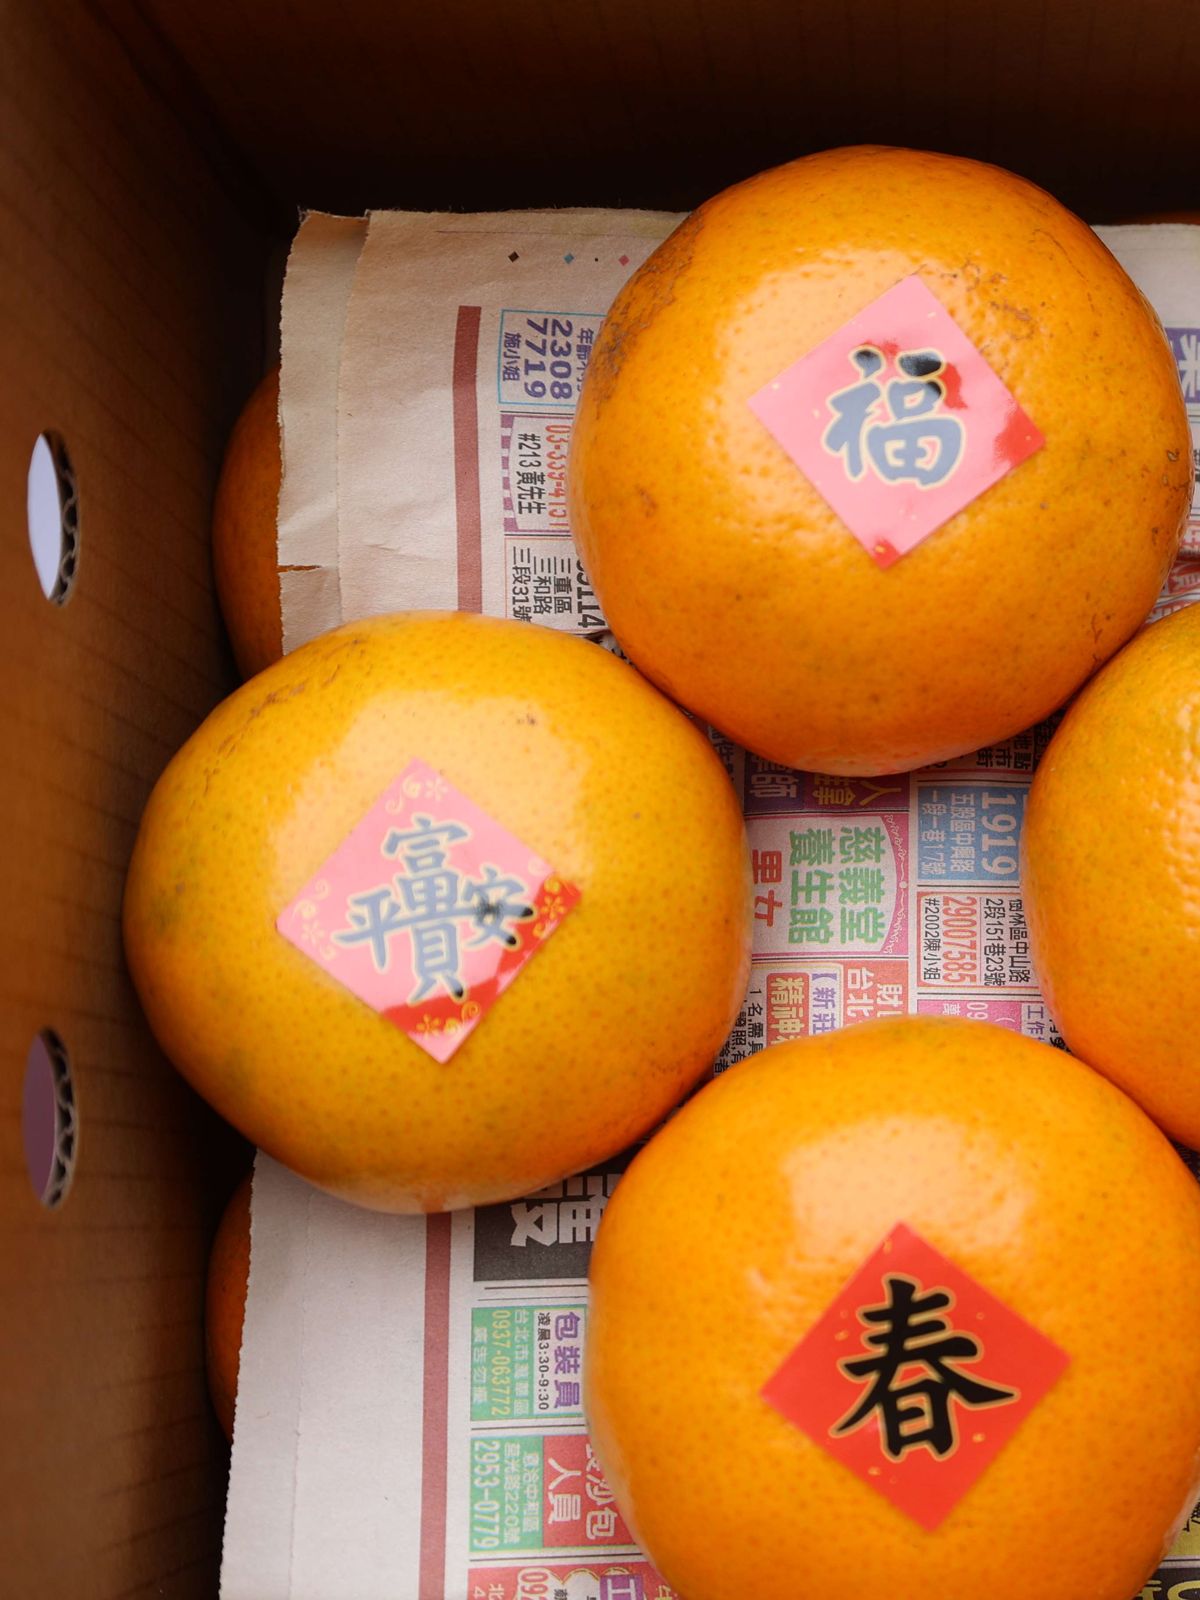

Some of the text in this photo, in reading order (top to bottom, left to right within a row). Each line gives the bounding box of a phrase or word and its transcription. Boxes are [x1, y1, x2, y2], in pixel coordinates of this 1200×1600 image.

[503, 332, 522, 381] 施小姐
[523, 317, 547, 399] 7719
[550, 318, 573, 400] 2308
[823, 346, 965, 487] 福
[512, 546, 531, 621] 三段31號
[532, 557, 553, 615] 三和路
[552, 557, 573, 614] 三重區
[920, 790, 947, 875] 一段一巷17號
[950, 793, 976, 873] 五股區中興路
[981, 791, 1017, 876] 1919
[788, 828, 835, 945] 養生館
[838, 826, 886, 944] 慈義堂
[922, 897, 941, 981] #2002陳小姐
[942, 896, 978, 984] 29007585
[983, 897, 1006, 986] 2段151巷23號
[489, 1309, 513, 1416] 0937-063772
[536, 1311, 552, 1411] 凌晨3:30-9:30
[553, 1311, 580, 1409] 包裝員
[831, 1275, 1017, 1461] 春
[474, 1441, 500, 1549] 2953-0779
[546, 1457, 581, 1525] 人員
